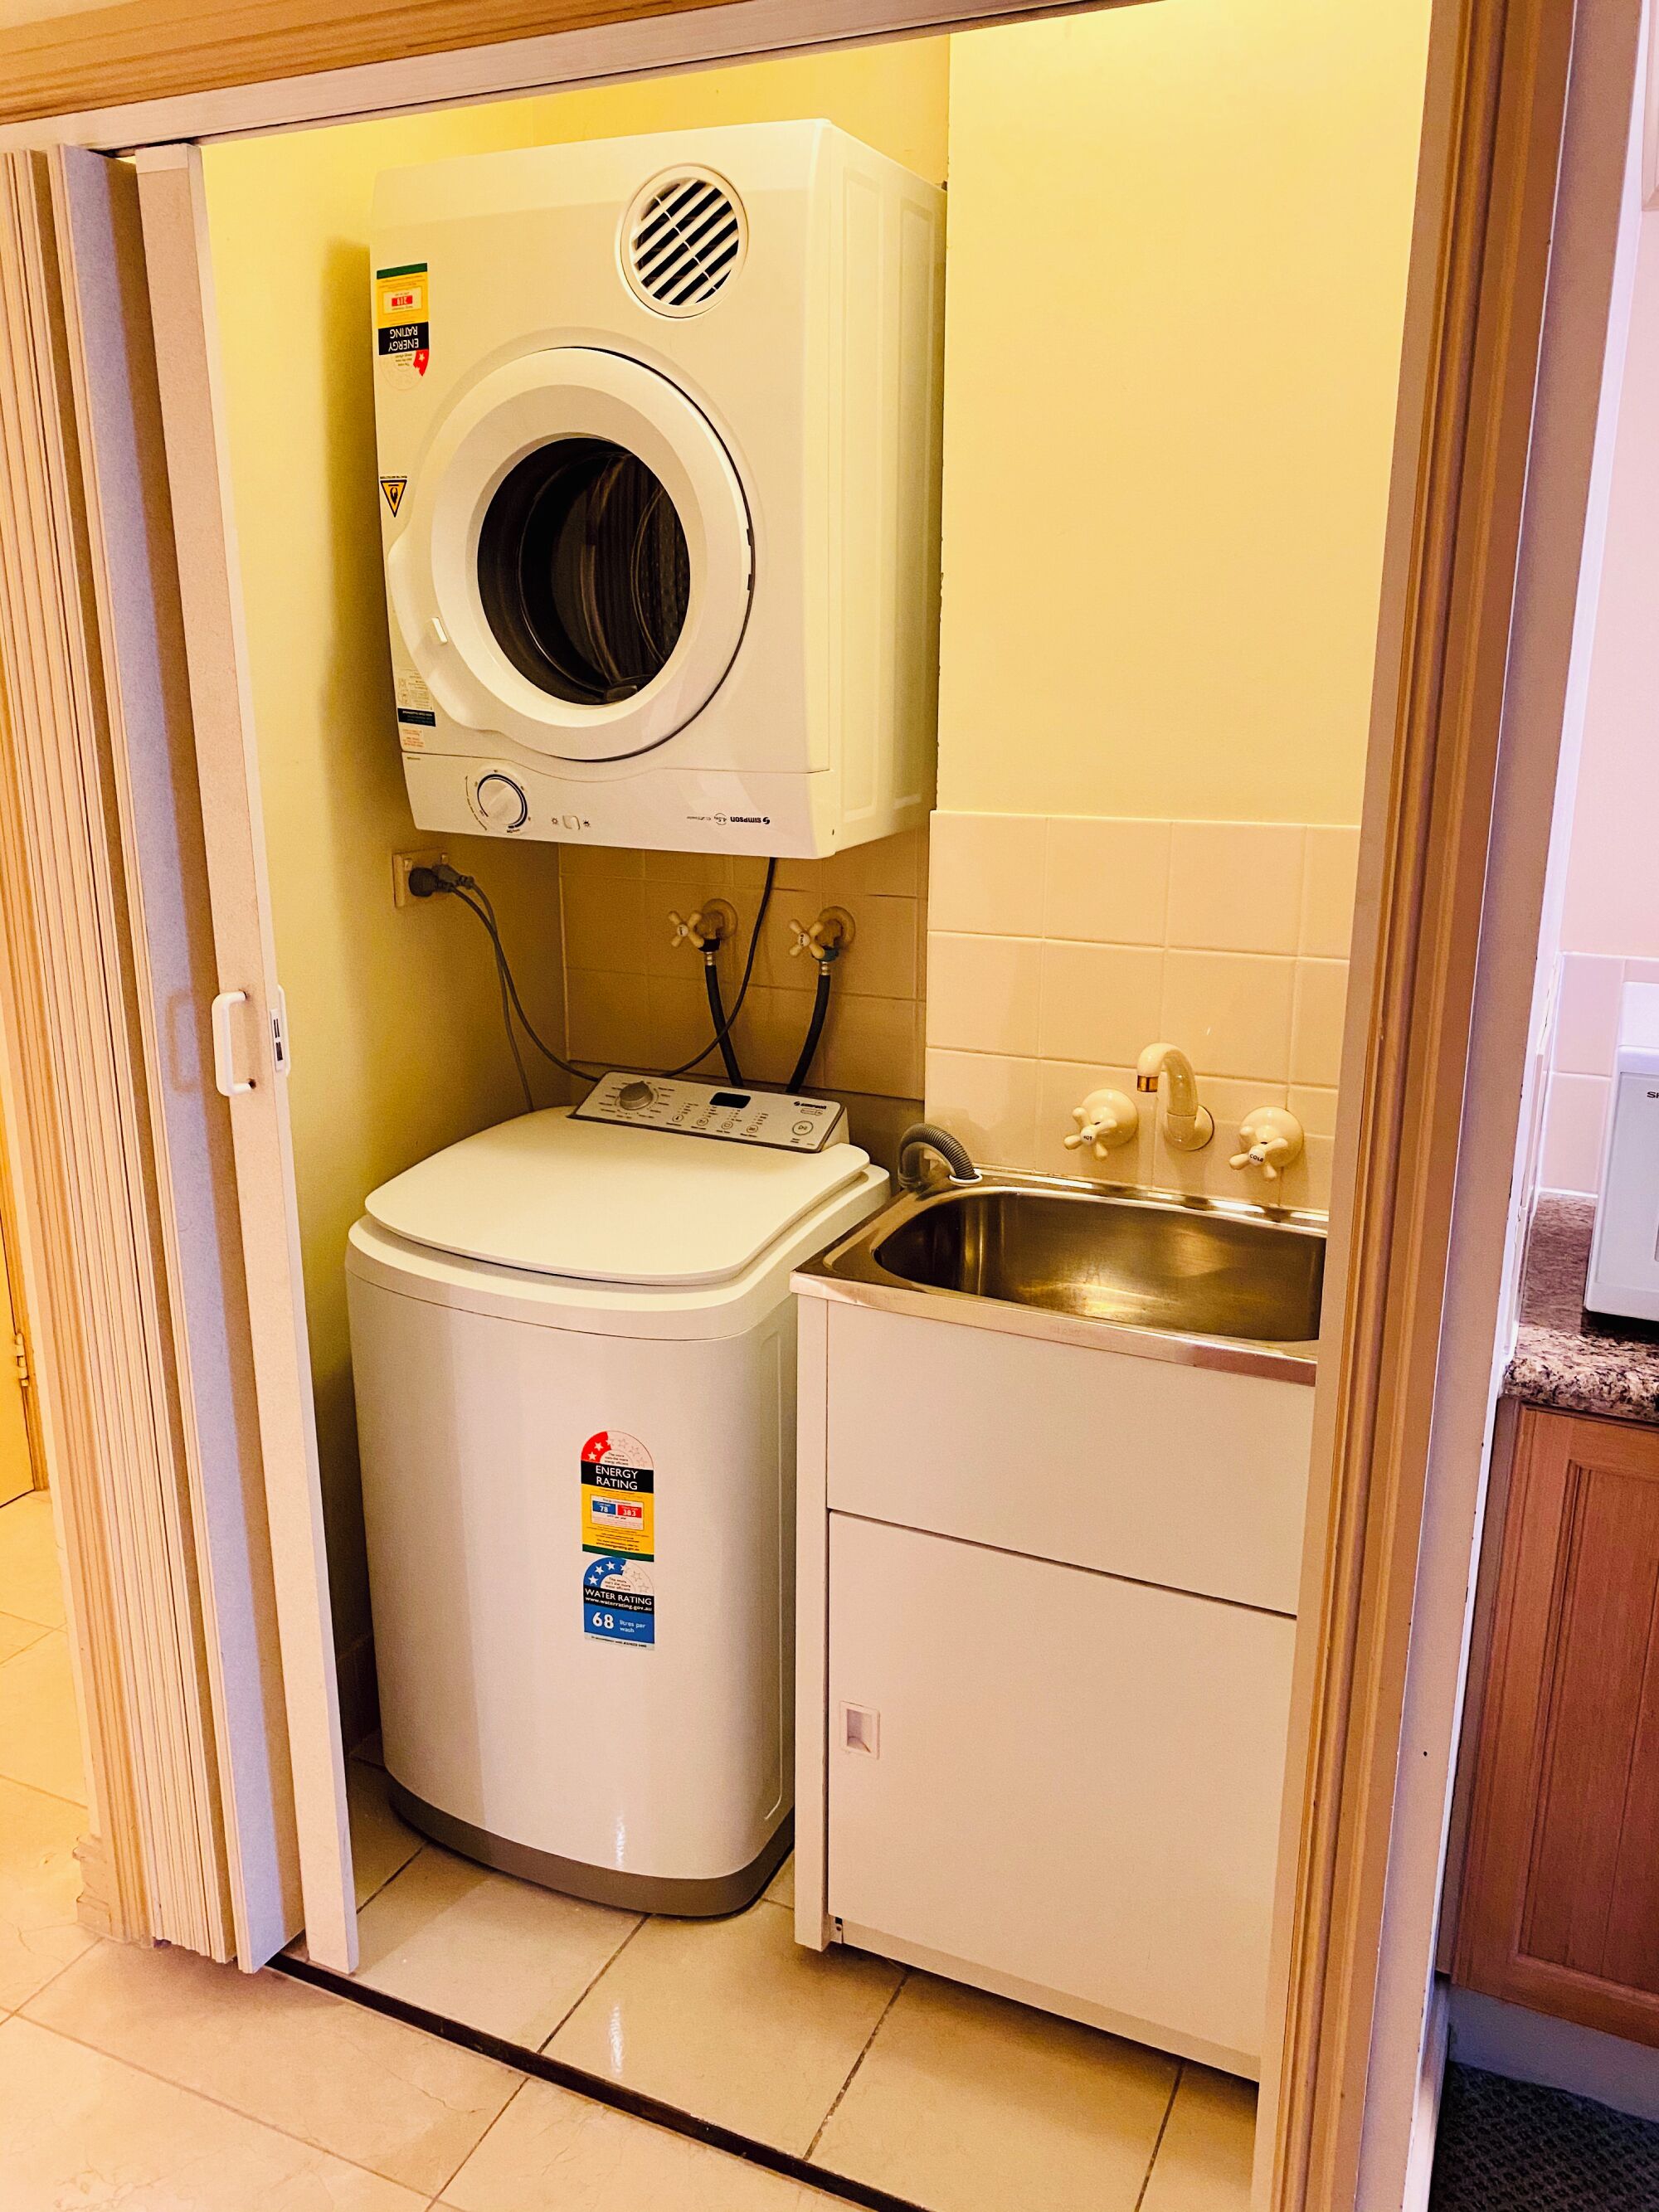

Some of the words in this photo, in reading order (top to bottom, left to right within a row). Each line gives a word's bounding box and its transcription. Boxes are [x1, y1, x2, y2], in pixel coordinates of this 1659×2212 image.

[389, 325, 418, 339] RATING
[388, 338, 419, 352] ENERGY
[1249, 1154, 1264, 1162] COLD
[596, 1466, 639, 1480] ENERGY
[596, 1476, 638, 1490] RATING
[584, 1587, 615, 1600] WATER
[617, 1594, 652, 1606] RATING
[585, 1597, 653, 1611] www.waterrating.gov.au
[592, 1612, 615, 1629] 68
